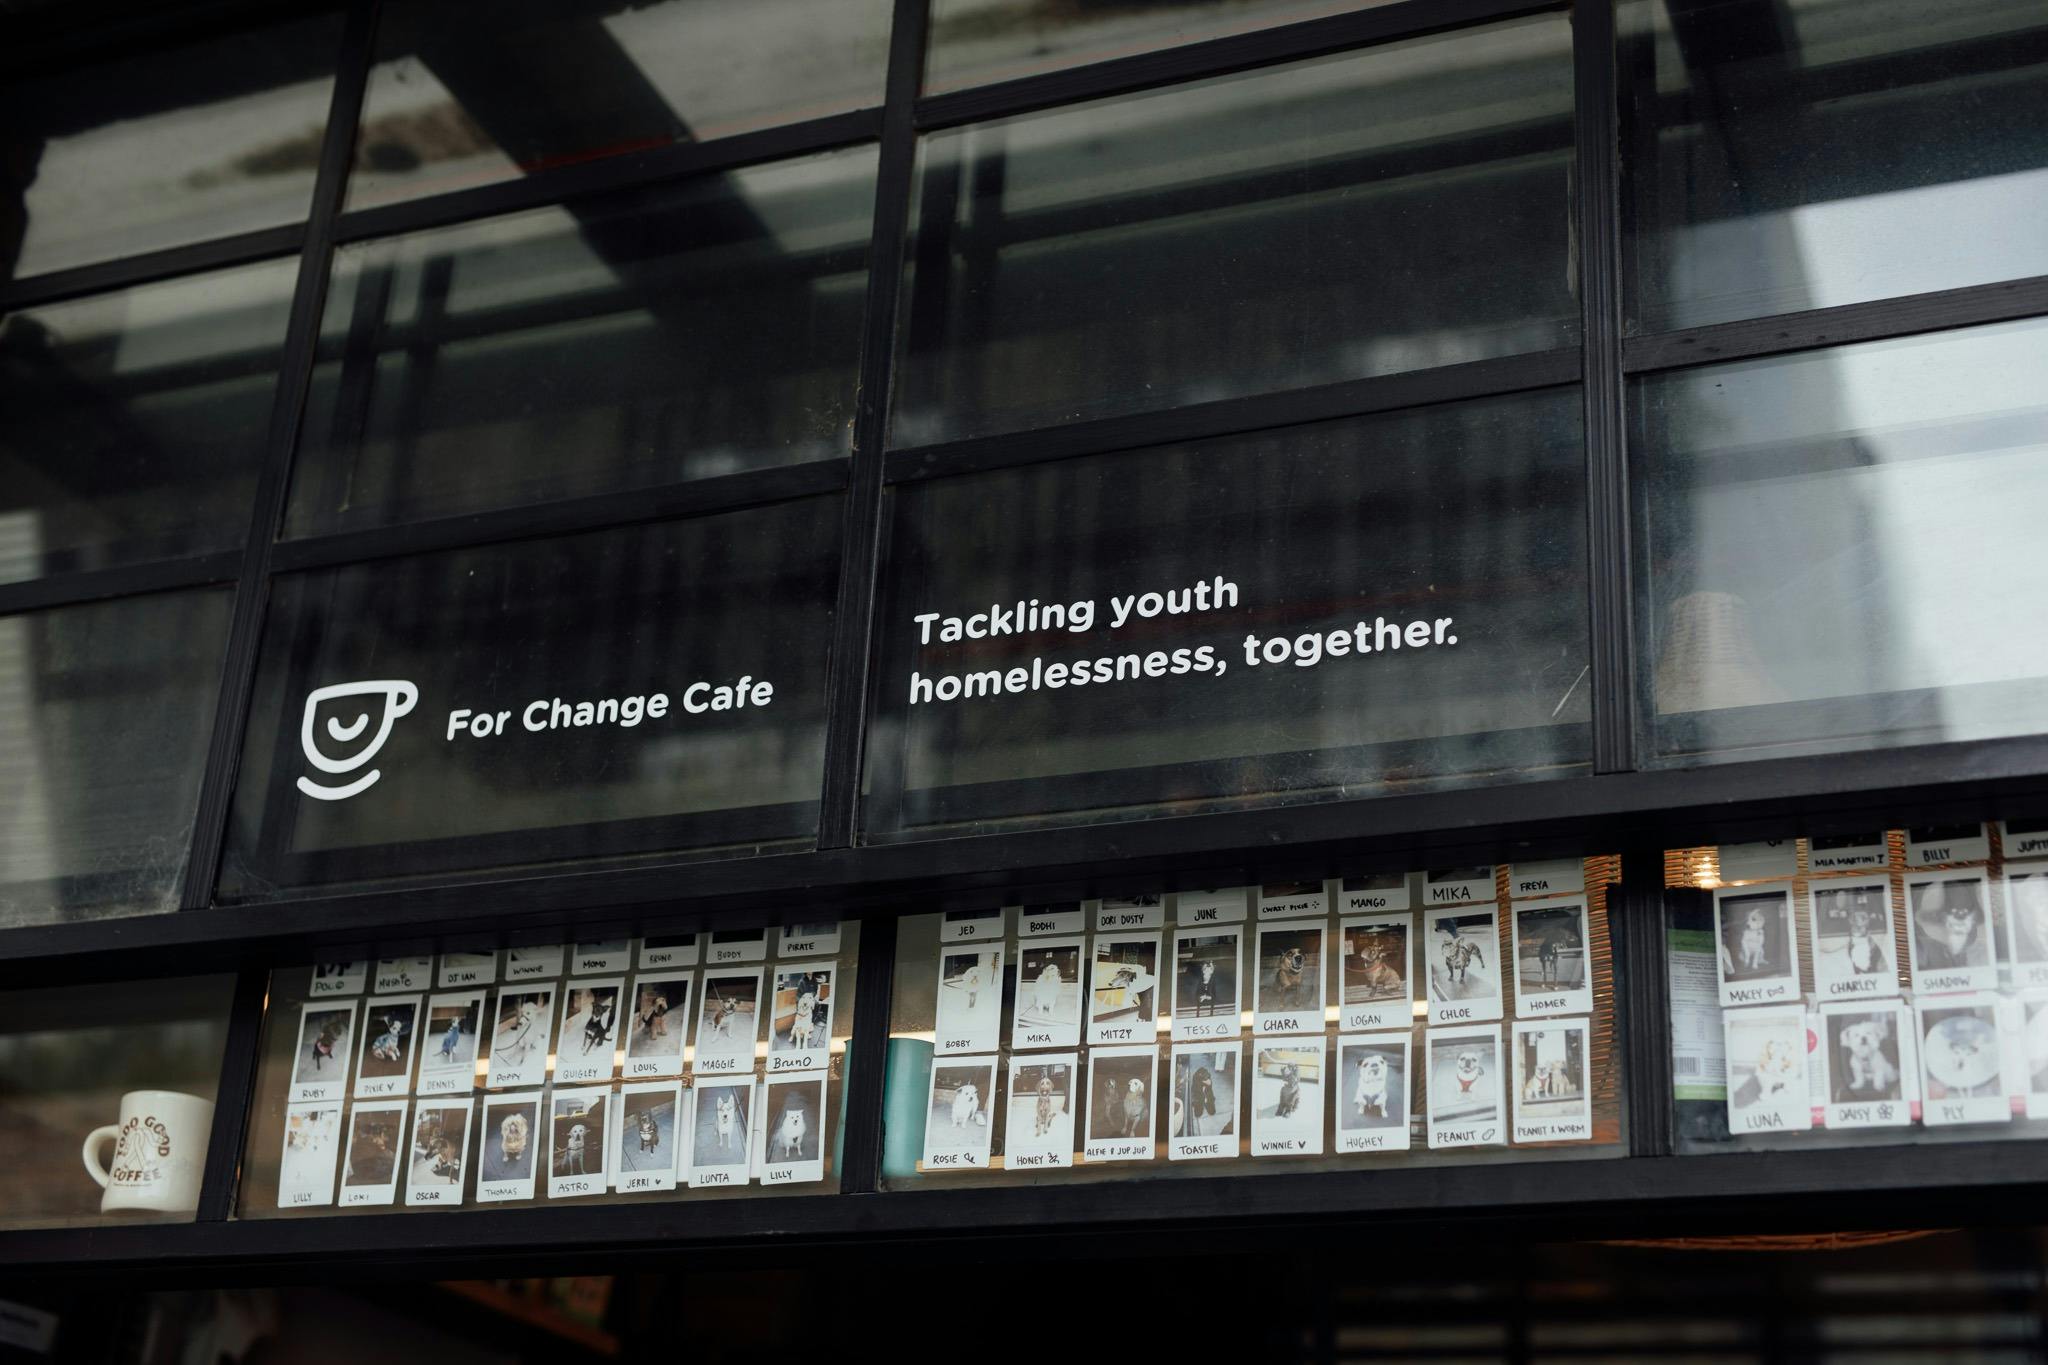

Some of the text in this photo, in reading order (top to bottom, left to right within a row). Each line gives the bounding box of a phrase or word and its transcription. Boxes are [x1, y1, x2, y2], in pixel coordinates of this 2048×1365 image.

[914, 575, 1239, 645] Tackling youth
[909, 617, 1458, 705] homelessness, together.
[447, 675, 773, 741] For Change Cafe
[1922, 847, 1951, 862] BILLY
[1814, 855, 1875, 868] MIA MARTINI
[1520, 880, 1549, 892] FREYA
[1432, 886, 1471, 901] MIKA
[1350, 898, 1386, 908] MANGO
[1120, 914, 1145, 925] DUSTY
[1194, 907, 1217, 921] JUNE
[958, 925, 975, 936] JED
[1030, 922, 1055, 932] BODHI
[786, 941, 816, 953] PIRATE
[717, 950, 742, 961] BUDDY
[583, 959, 607, 969] MOMO
[461, 971, 477, 982] IAN
[1924, 975, 1970, 990] SHADOW
[1829, 980, 1877, 994] CHARLEY
[1530, 998, 1566, 1011] HOMER
[1440, 1008, 1471, 1020] CHLOE
[1263, 1018, 1299, 1031] CHARA
[1350, 1015, 1382, 1027] LOGAN
[1100, 1029, 1132, 1040] MITZY
[1184, 1025, 1210, 1036] TESS
[945, 1039, 971, 1049] BOBBY
[1027, 1033, 1052, 1043] MIKA
[633, 1063, 658, 1073] LOUIS
[702, 1058, 735, 1070] MAGGIE
[563, 1069, 598, 1079] QUIGLEY
[427, 1080, 456, 1090] DENNIS
[302, 1088, 326, 1099] RUBY
[1746, 1112, 1783, 1129] LUNA
[1838, 1107, 1870, 1122] DAISY
[1517, 1126, 1546, 1137] PEANUT
[1557, 1123, 1585, 1135] WORM
[1346, 1136, 1384, 1149] HUGHEY
[1437, 1130, 1477, 1144] PEANUT
[1117, 1146, 1131, 1155] JUP
[1133, 1146, 1147, 1154] JUP
[1179, 1144, 1219, 1156] TOASTIE
[1261, 1140, 1293, 1151] WINNIE
[933, 1153, 958, 1165] ROSIE
[1016, 1154, 1044, 1166] HONEY
[113, 1168, 162, 1181] COFFEE
[700, 1173, 730, 1184] LUNTA
[770, 1169, 793, 1180] LILLY
[558, 1182, 589, 1193] ASTRO
[627, 1178, 650, 1189] JERRI
[415, 1191, 440, 1202] OSCAR
[485, 1187, 518, 1198] THOMAS
